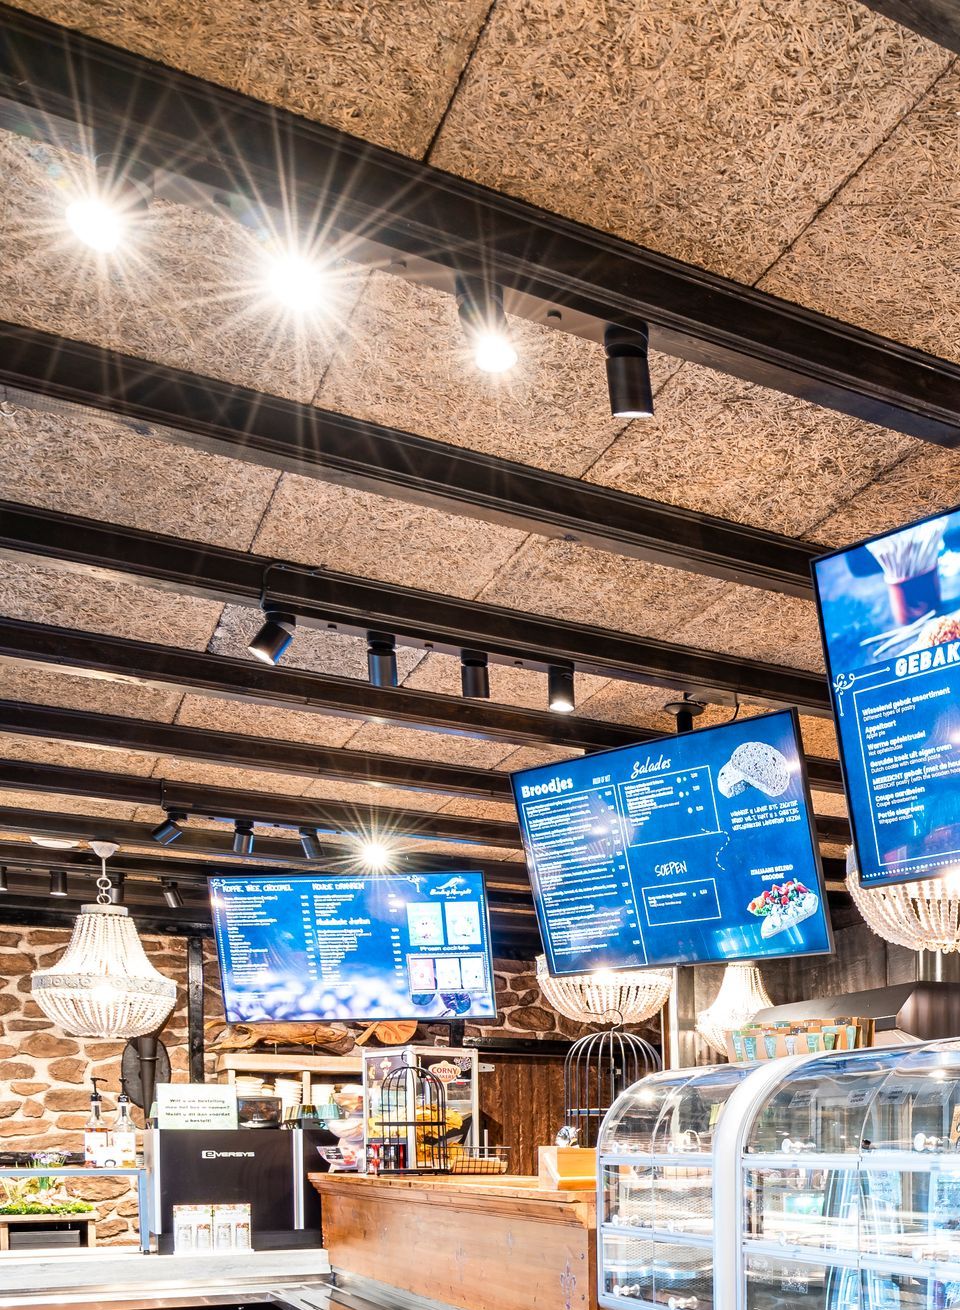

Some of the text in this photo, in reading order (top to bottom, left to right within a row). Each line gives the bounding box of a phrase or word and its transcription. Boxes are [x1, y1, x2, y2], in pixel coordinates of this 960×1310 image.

[895, 642, 960, 676] GEBAK
[630, 754, 671, 779] Salades
[521, 777, 573, 798] Broodjes
[654, 860, 687, 876] SOEPEN
[431, 1066, 458, 1075] CORNY
